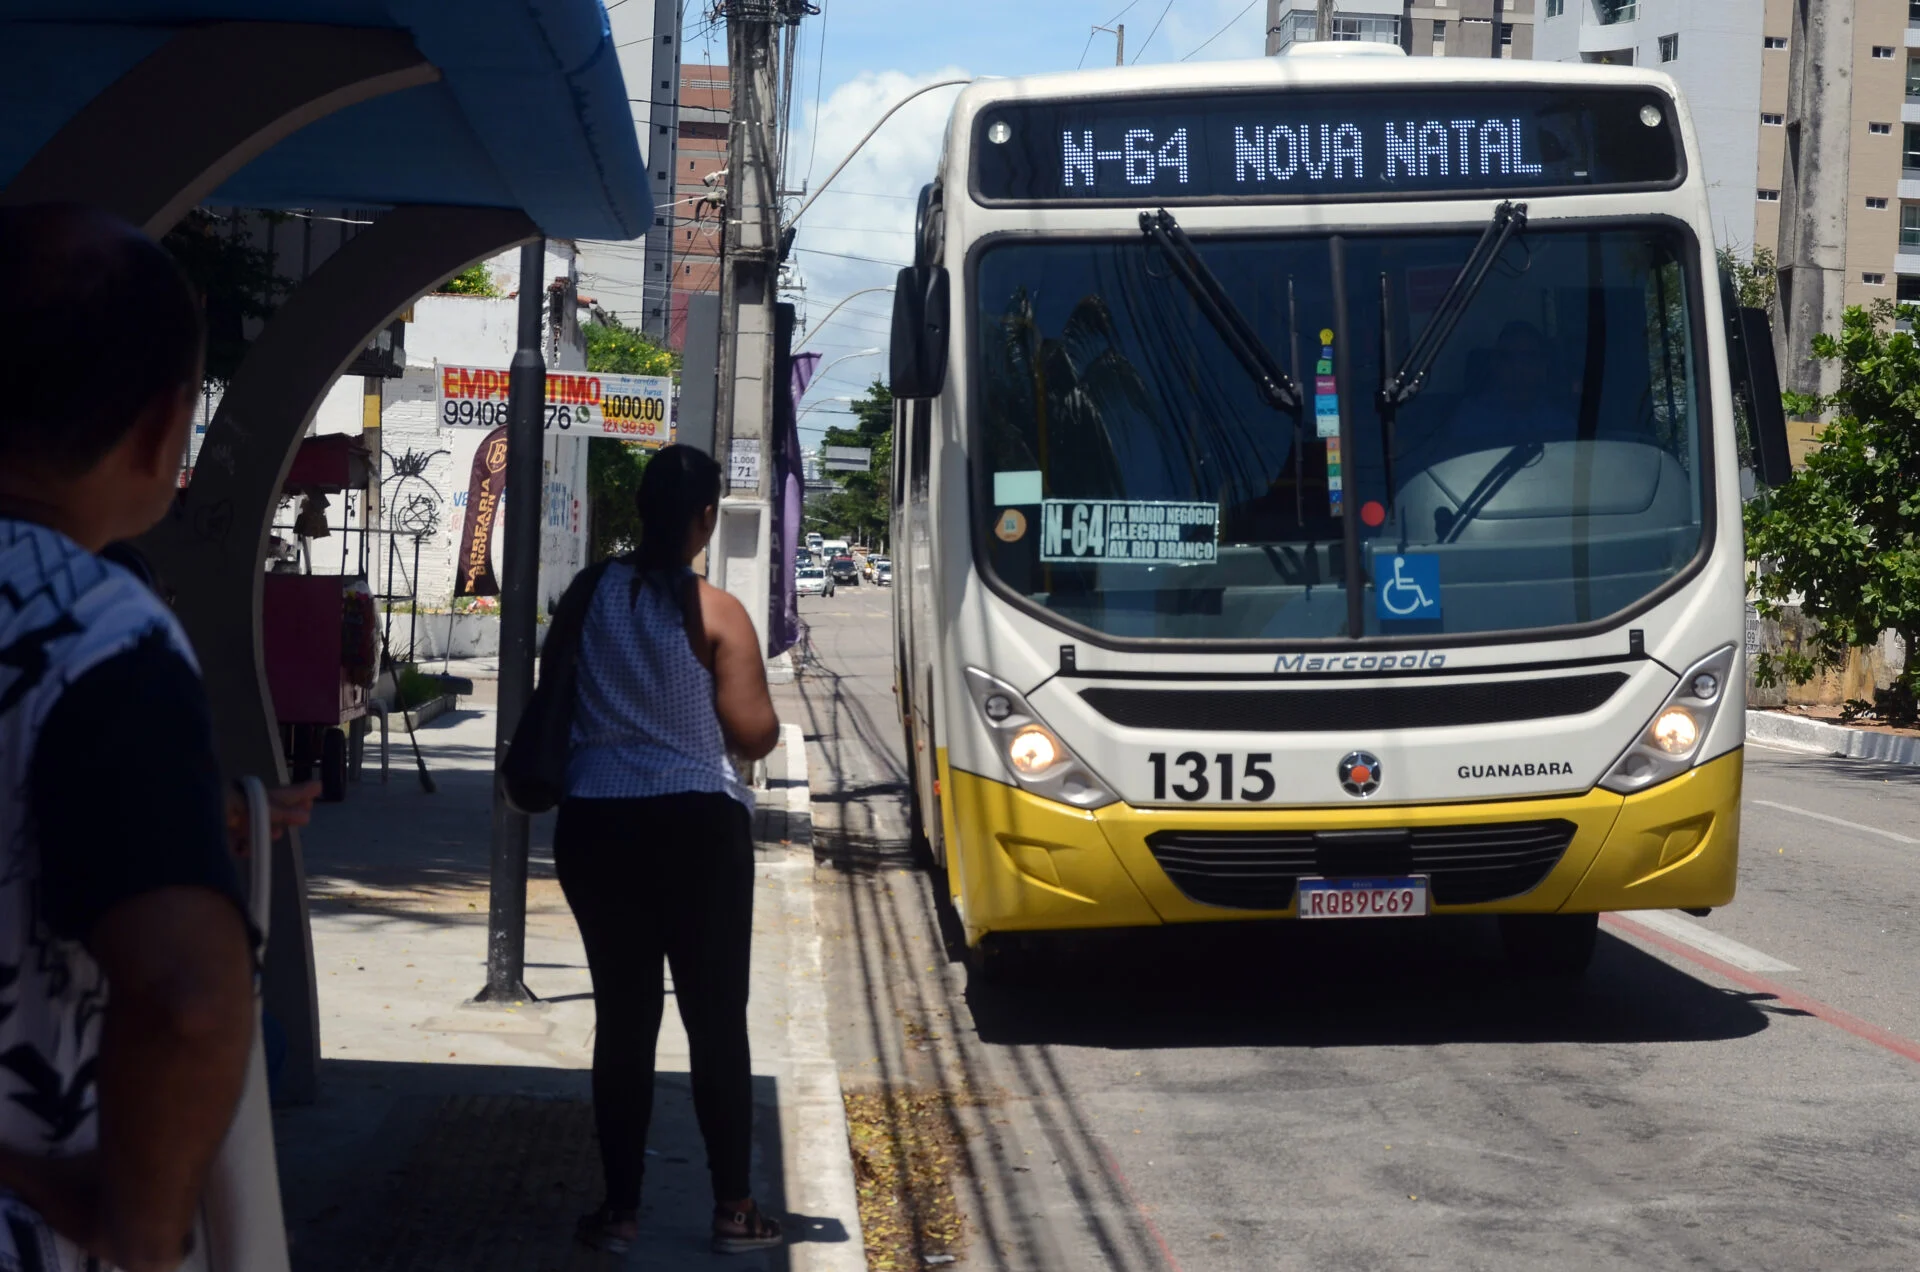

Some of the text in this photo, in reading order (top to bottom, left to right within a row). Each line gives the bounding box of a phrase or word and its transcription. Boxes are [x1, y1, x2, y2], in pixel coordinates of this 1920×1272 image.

[1063, 117, 1543, 187] N-64 NOVA NATAL
[737, 466, 751, 477] 71
[1109, 506, 1127, 523] AV.
[1045, 503, 1105, 556] N-64
[1109, 523, 1180, 541] ALECRIM
[1109, 541, 1215, 559] AV. RIO BRANCO
[1273, 650, 1447, 673] Marcopolo
[1148, 751, 1276, 802] 1315
[1457, 762, 1573, 779] GUANABARA
[1311, 890, 1414, 915] RQB9C69
